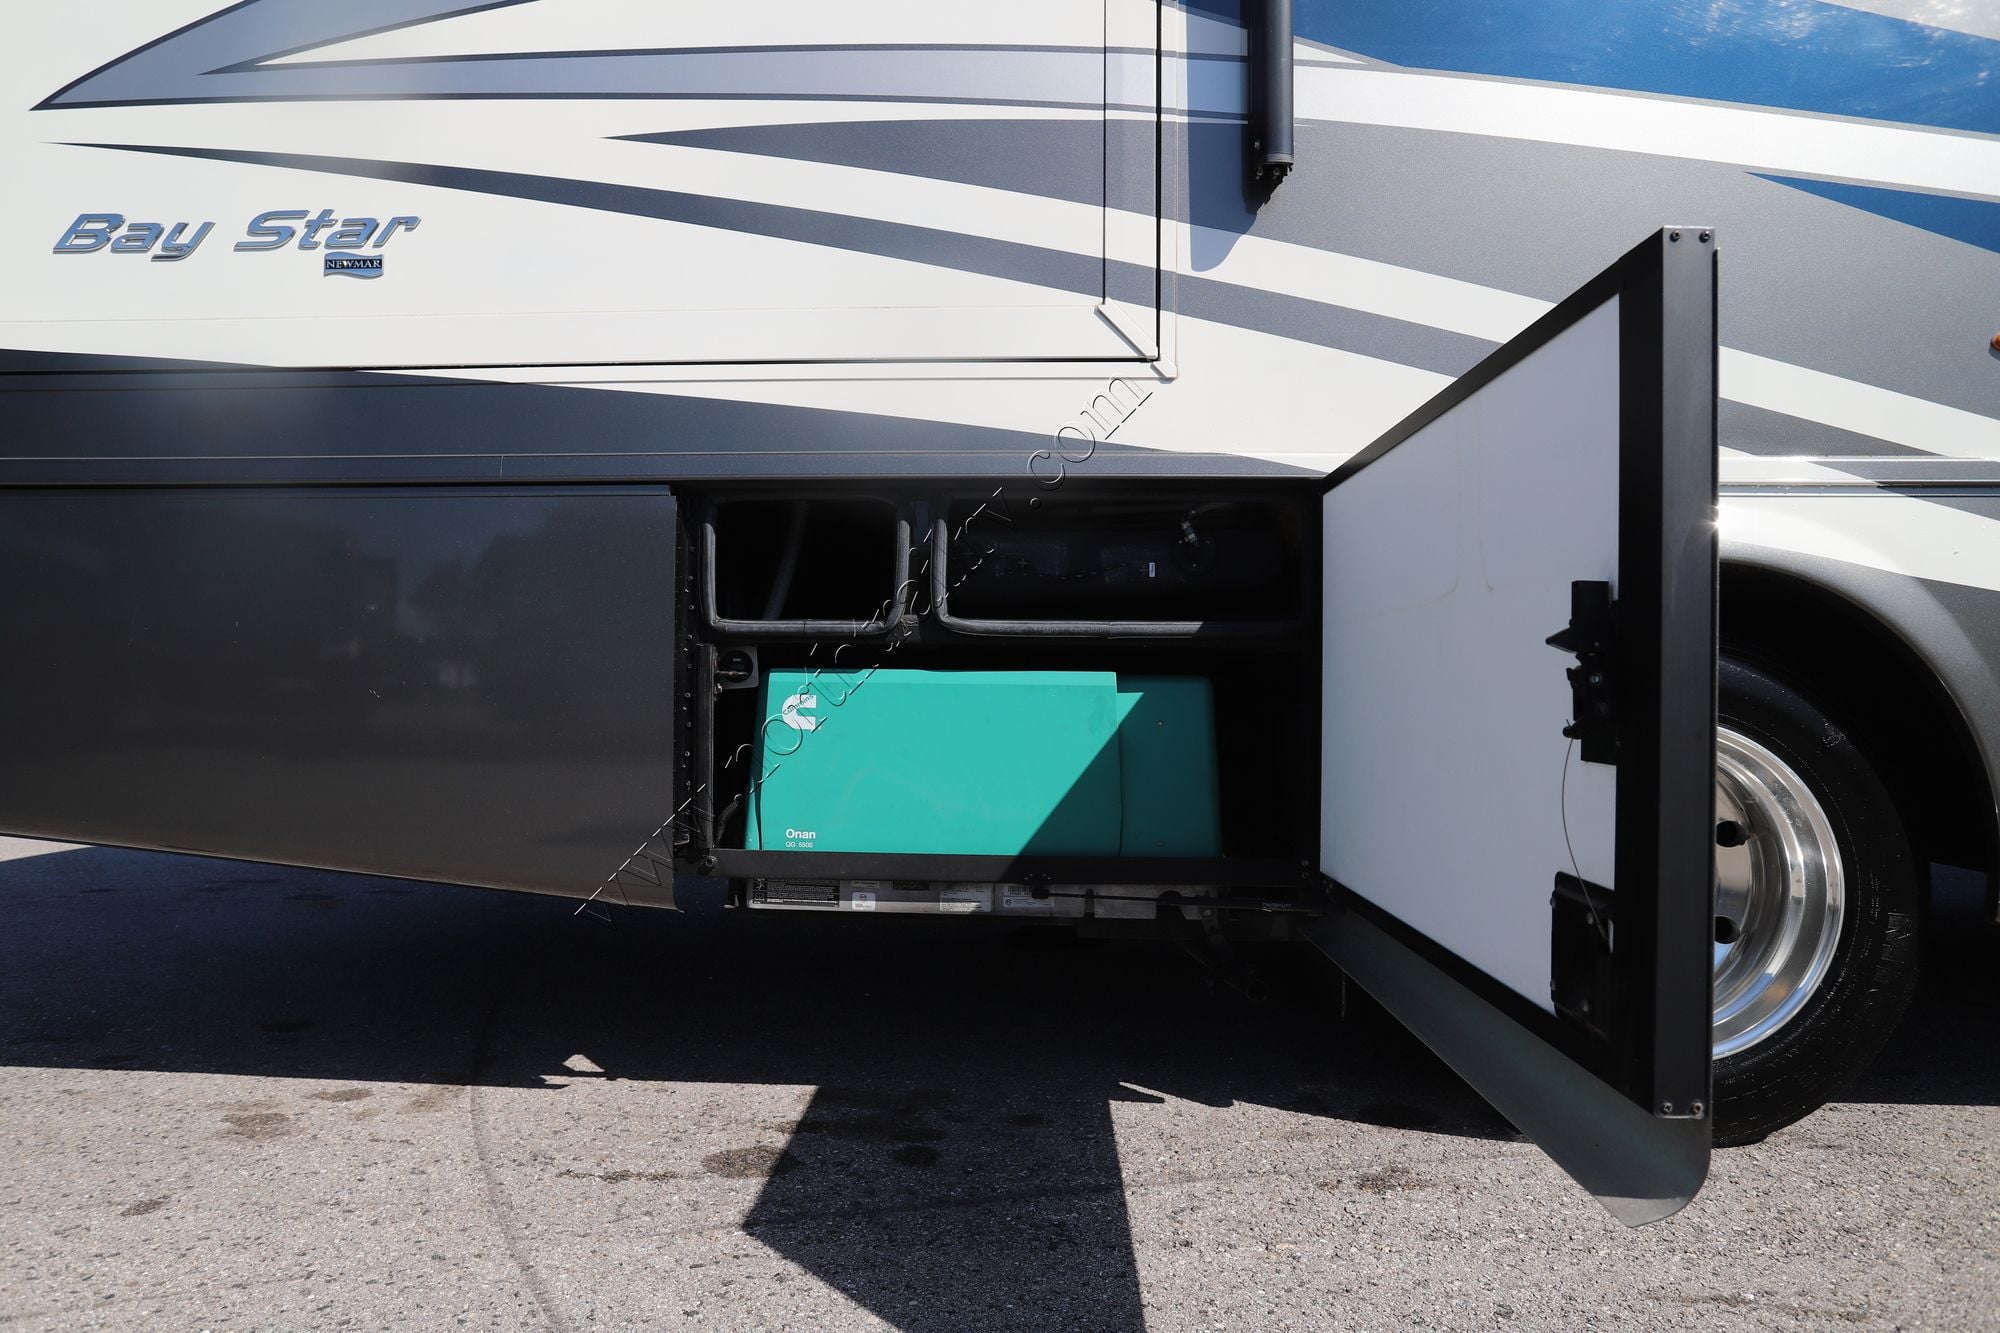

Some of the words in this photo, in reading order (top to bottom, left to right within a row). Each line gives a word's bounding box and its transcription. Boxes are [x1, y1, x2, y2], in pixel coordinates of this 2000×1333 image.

[53, 213, 216, 262] Bay
[233, 209, 421, 252] Star
[326, 260, 381, 268] NEWMAR
[785, 828, 816, 839] Onan
